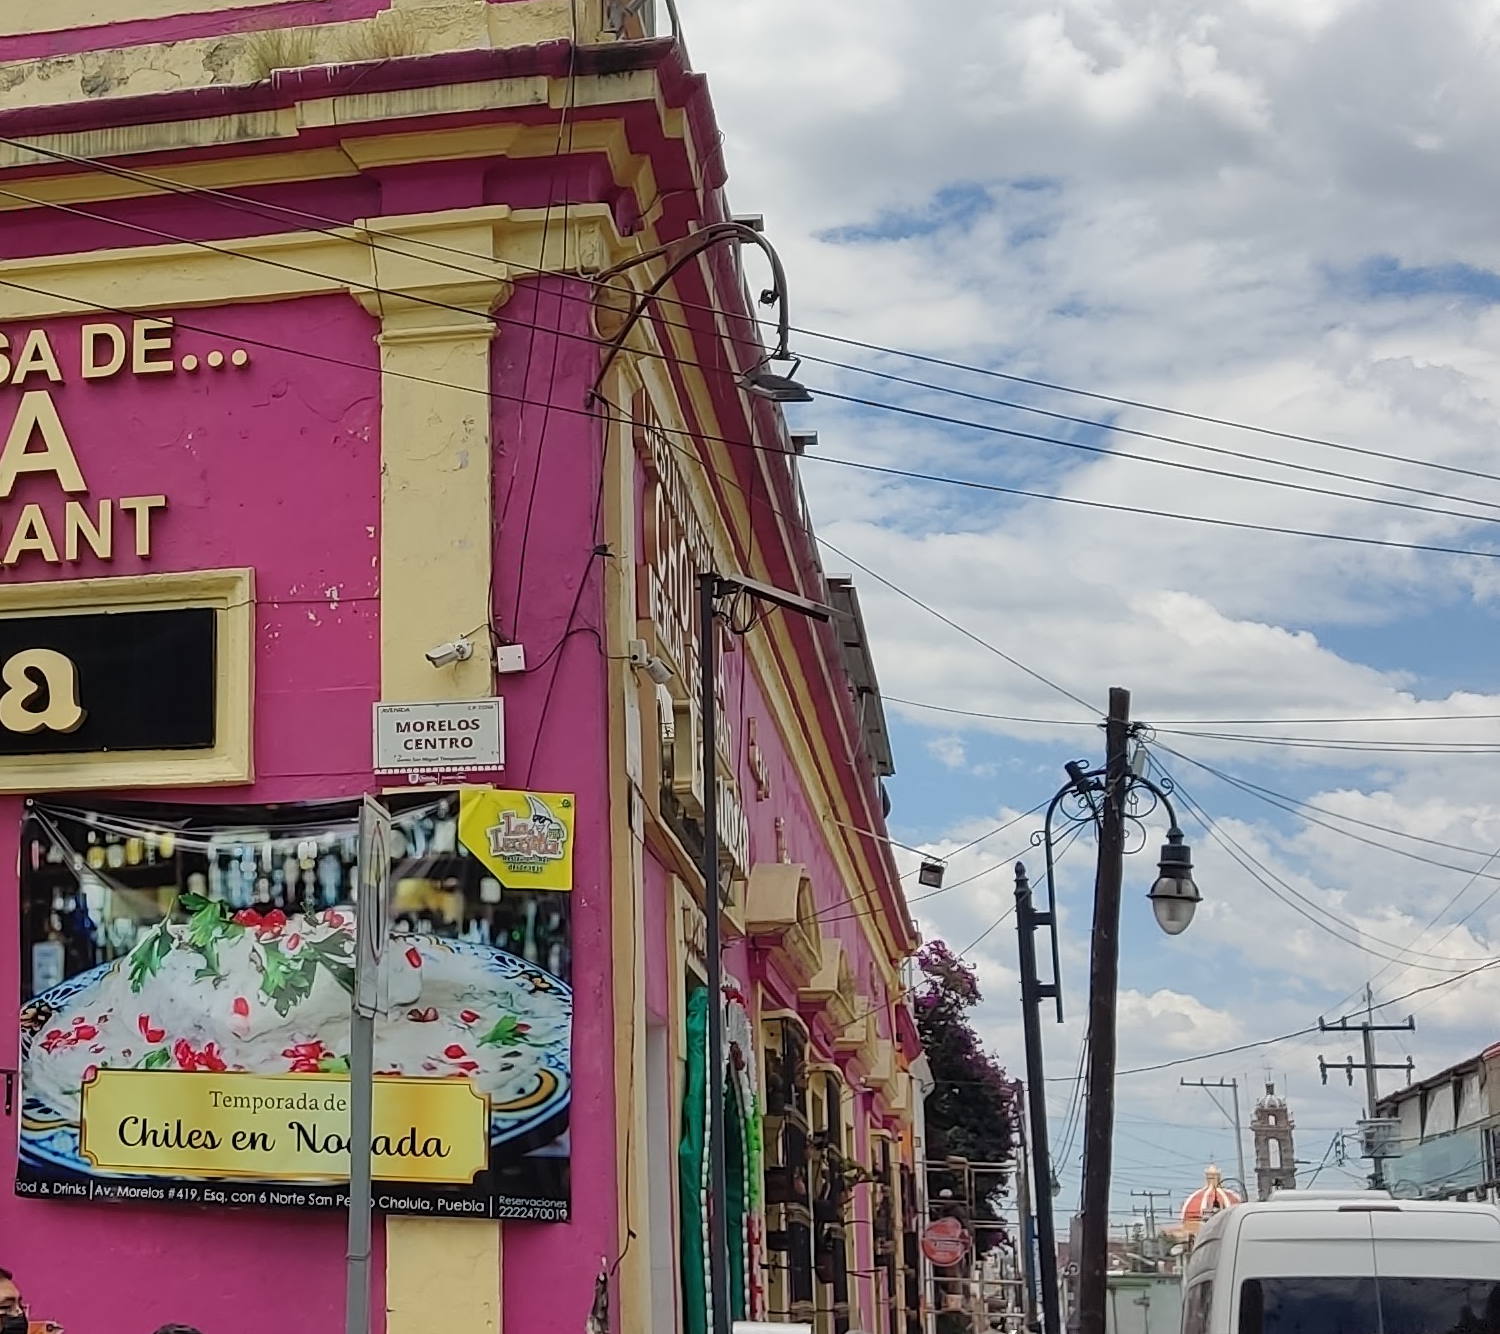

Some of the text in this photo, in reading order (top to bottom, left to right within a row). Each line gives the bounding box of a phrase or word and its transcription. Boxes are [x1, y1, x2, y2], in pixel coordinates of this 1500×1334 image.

[395, 718, 481, 734] MORELOS
[403, 736, 474, 751] CENTRO
[209, 1090, 347, 1115] Temporada de
[118, 1116, 452, 1159] Chiles en Noada
[16, 1179, 87, 1196] ood & Drinks
[95, 1184, 115, 1198] Av.
[117, 1186, 164, 1200] Morelos
[168, 1188, 200, 1202] #419,
[204, 1189, 228, 1204] Esq.
[232, 1192, 256, 1204] con
[259, 1191, 267, 1204] 6
[270, 1192, 305, 1206] Norte
[308, 1193, 333, 1207] San
[379, 1195, 434, 1212] Cholula,
[437, 1198, 485, 1213] Puebla
[499, 1195, 567, 1208] Reservaciones
